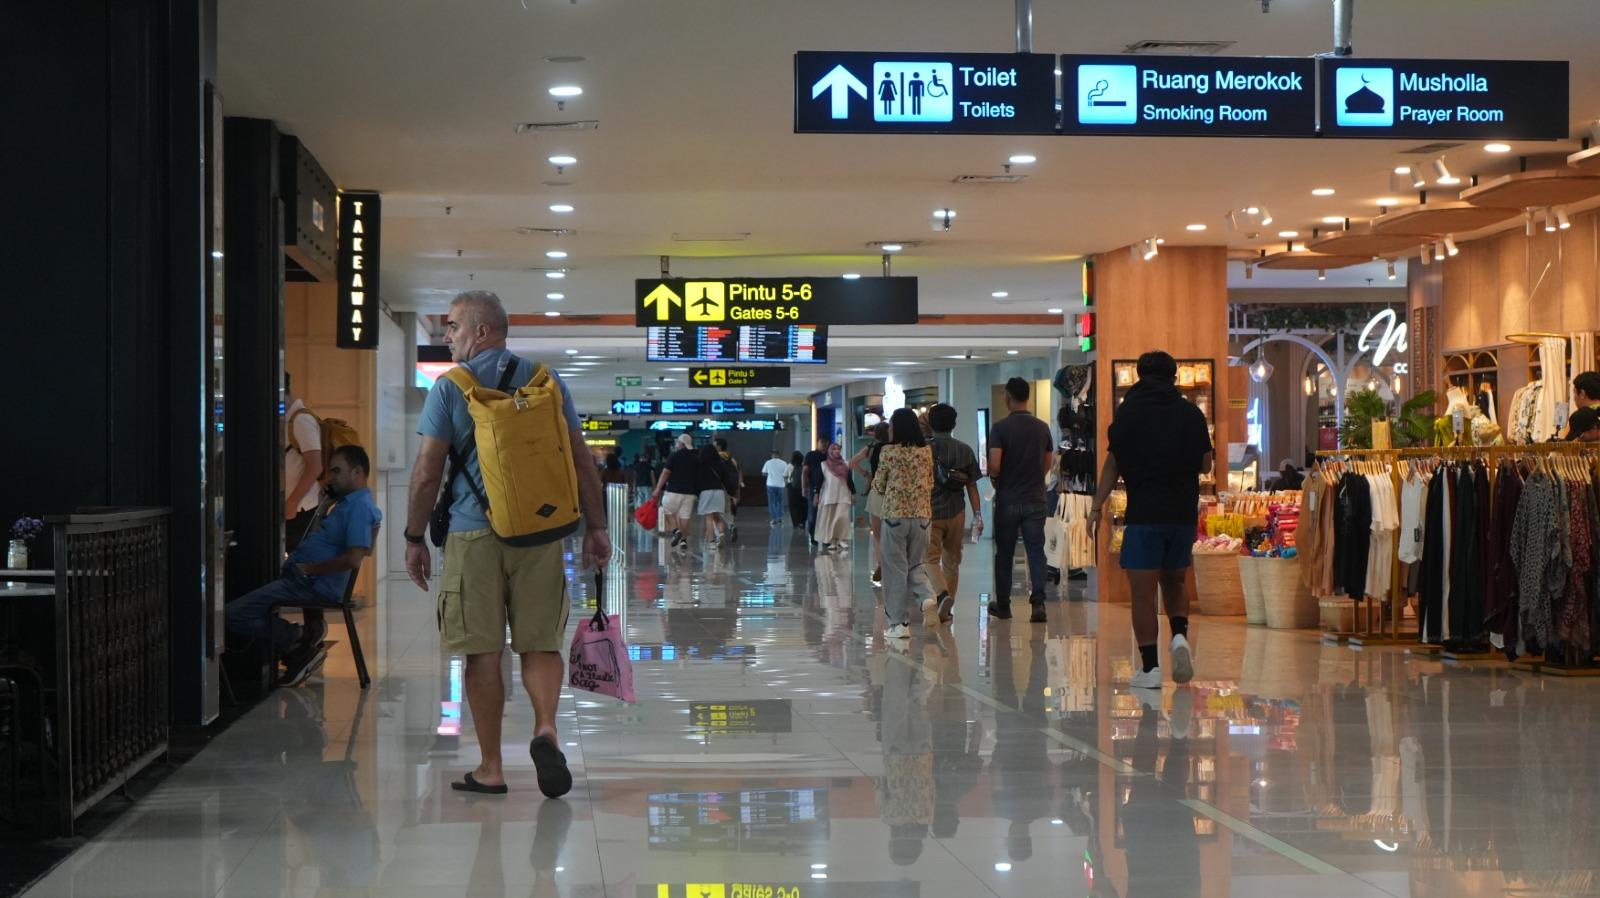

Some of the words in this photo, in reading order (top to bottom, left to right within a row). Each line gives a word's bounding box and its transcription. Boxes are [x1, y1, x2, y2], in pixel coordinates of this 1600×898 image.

[959, 66, 1017, 87] Toilet
[1142, 69, 1209, 94] Ruang
[1215, 70, 1302, 91] Merokok
[1400, 72, 1488, 92] Musholla
[959, 102, 1015, 118] Toilets
[1142, 104, 1214, 124] Smoking
[1219, 105, 1267, 121] Room
[1400, 106, 1452, 124] Prayer
[1456, 106, 1503, 121] Room
[351, 201, 364, 341] TAKEAWAY
[729, 284, 776, 300] Pintu
[782, 284, 812, 301] 5-6
[730, 306, 772, 320] Gates
[776, 306, 799, 319] 5-6
[728, 369, 748, 377] Pintu
